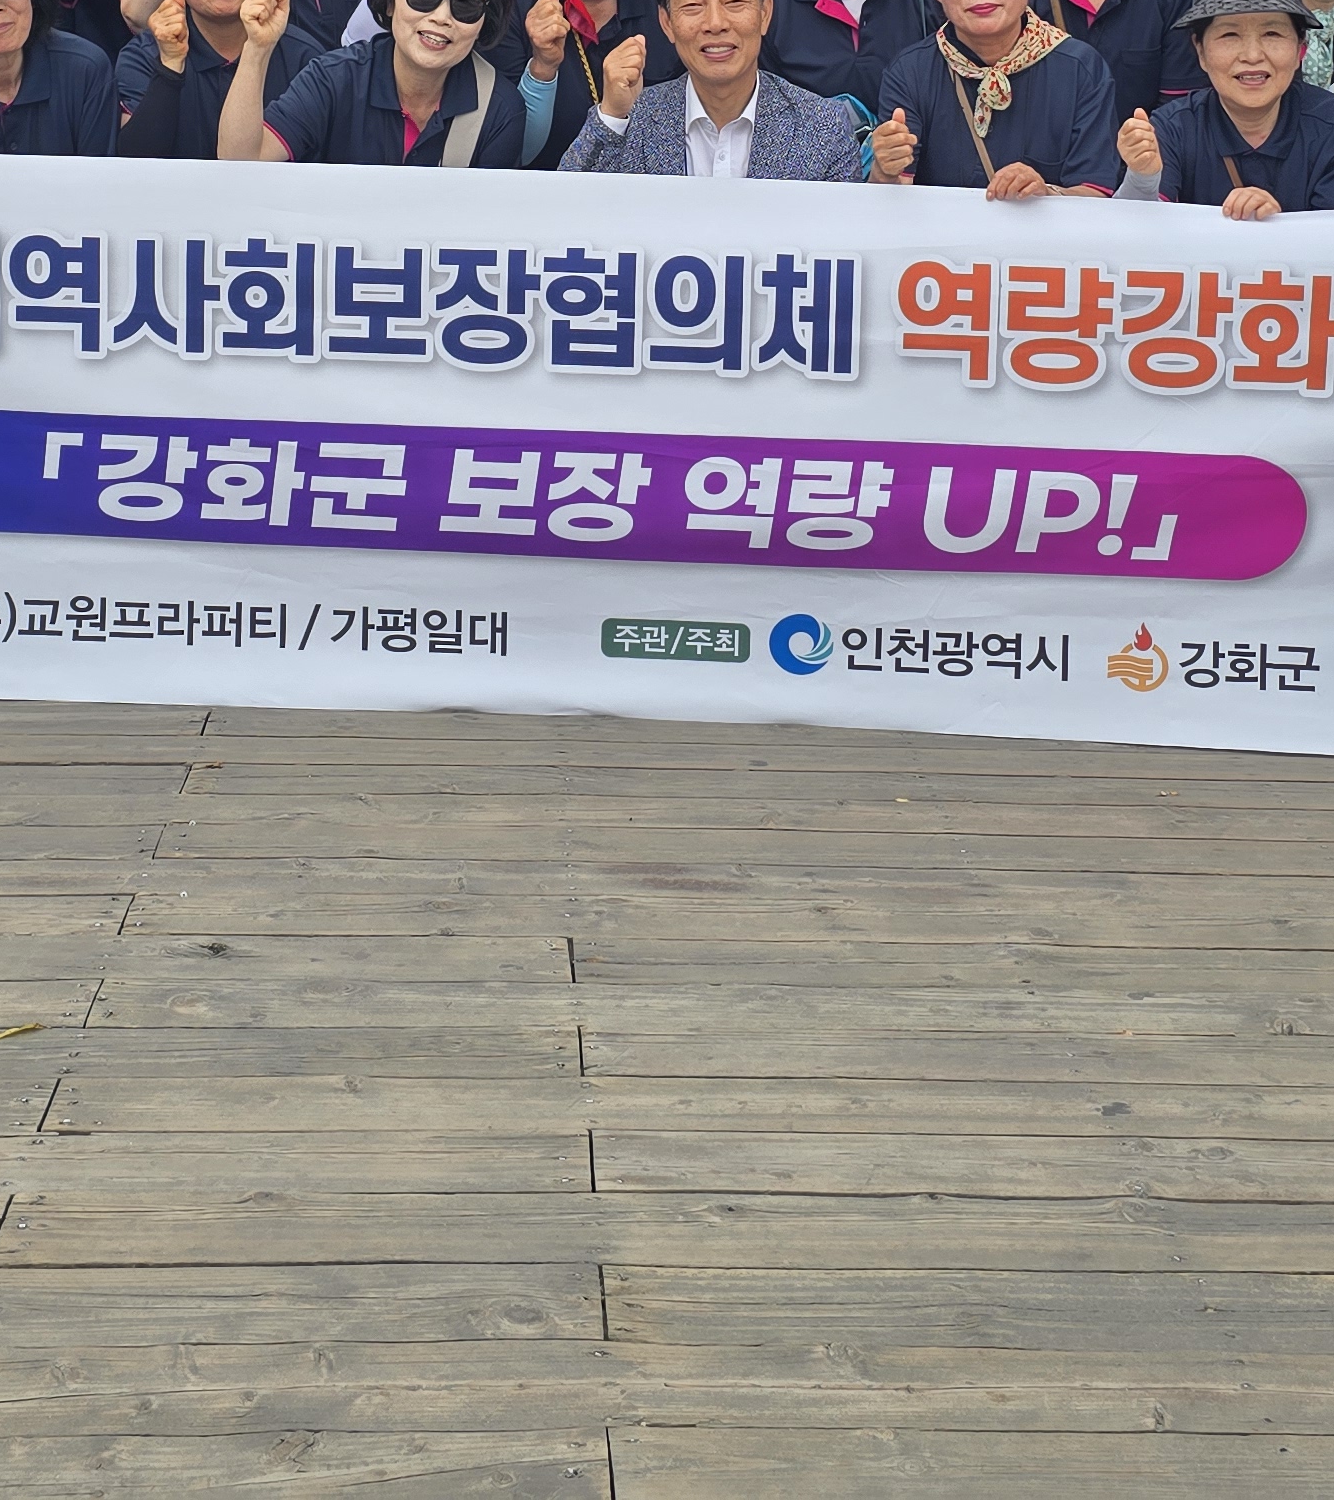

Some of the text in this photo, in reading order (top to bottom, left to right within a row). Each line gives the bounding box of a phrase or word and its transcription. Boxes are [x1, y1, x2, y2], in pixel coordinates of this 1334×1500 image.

[438, 448, 653, 543] 보장
[683, 455, 895, 551] 역량
[612, 624, 742, 657] 주관/주최
[840, 625, 1071, 682] 인천광역시
[1179, 640, 1321, 693] 강화군
